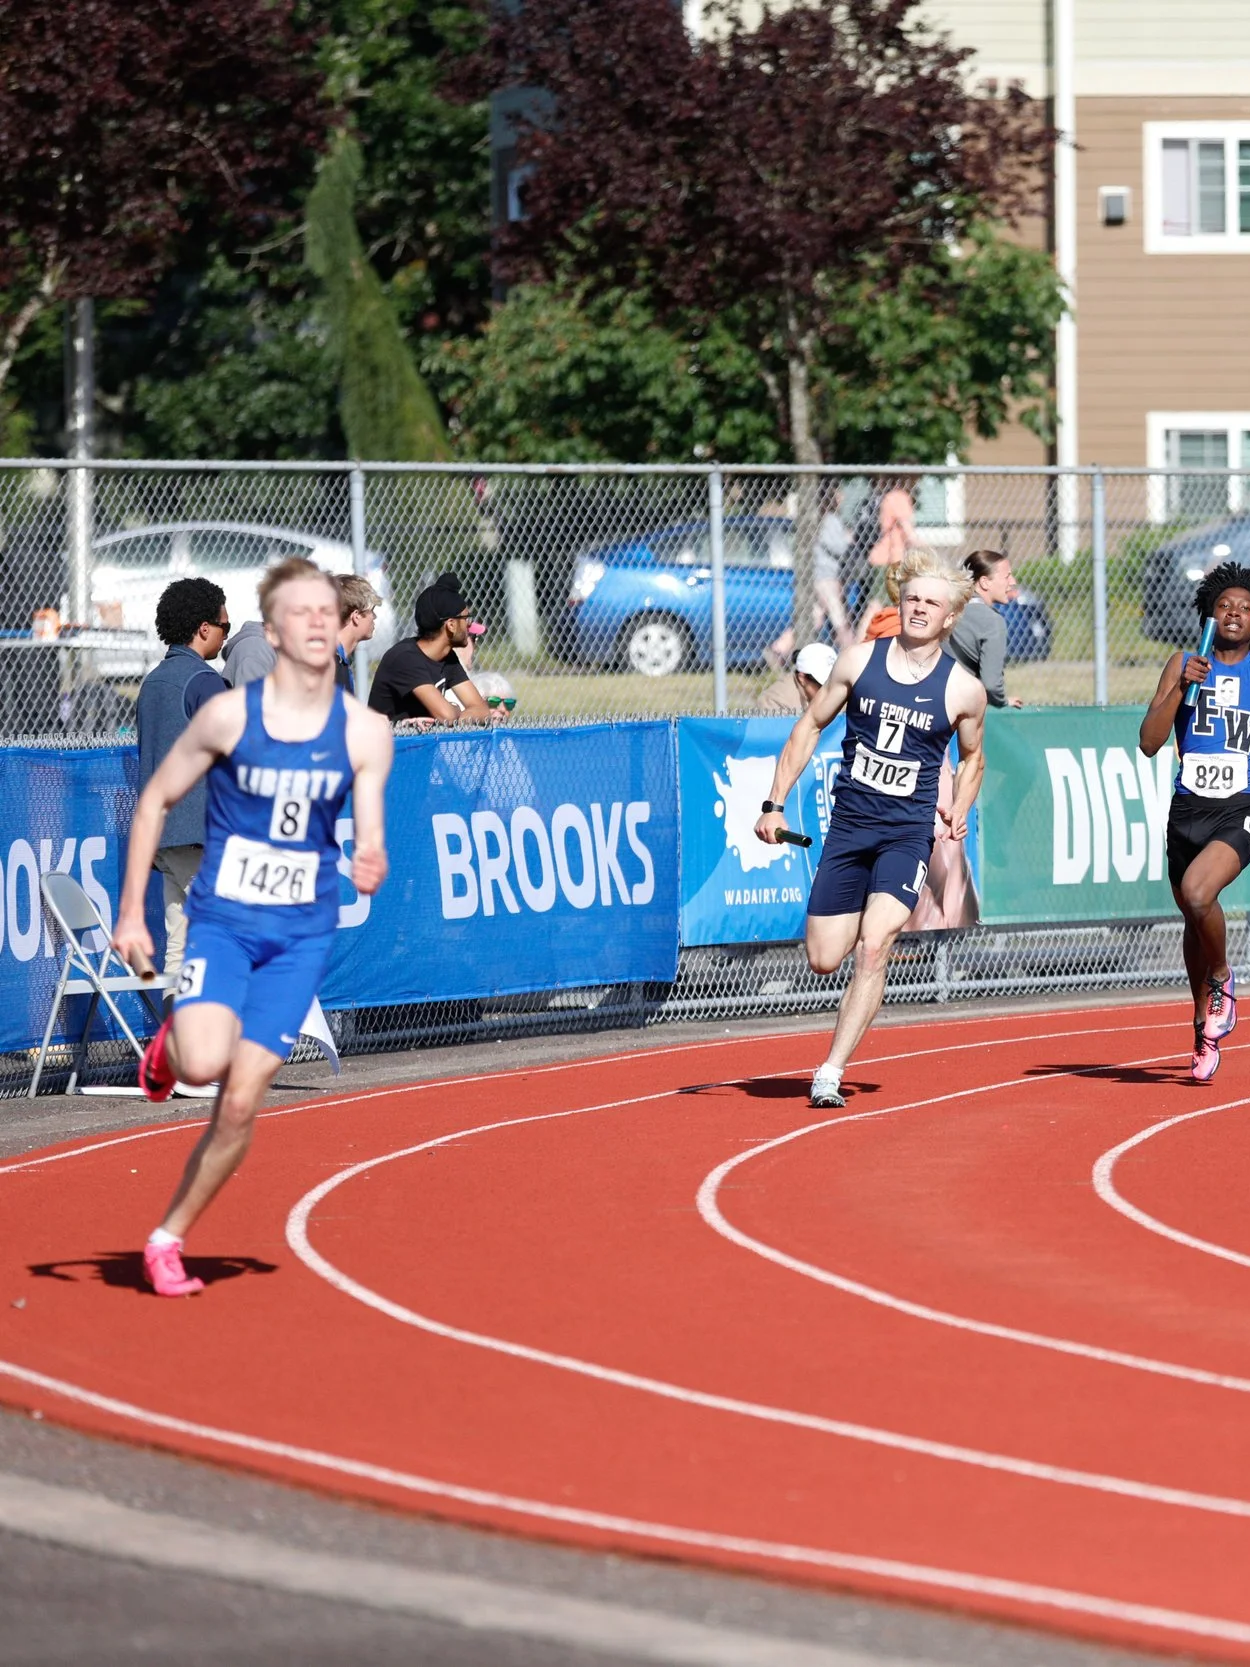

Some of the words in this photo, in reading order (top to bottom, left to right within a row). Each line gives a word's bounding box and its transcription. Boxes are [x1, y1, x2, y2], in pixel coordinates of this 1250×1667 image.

[860, 697, 876, 715] MT
[879, 702, 934, 731] SPOKANE
[884, 722, 900, 749] 7
[236, 765, 342, 800] LIBERTY
[862, 756, 911, 788] 1702
[1194, 765, 1234, 790] 829
[279, 801, 301, 836] 8
[432, 801, 655, 920] BROOKS
[236, 856, 306, 901] 1426
[0, 836, 112, 962] OKS
[724, 888, 803, 906] WADAIRY.ORG
